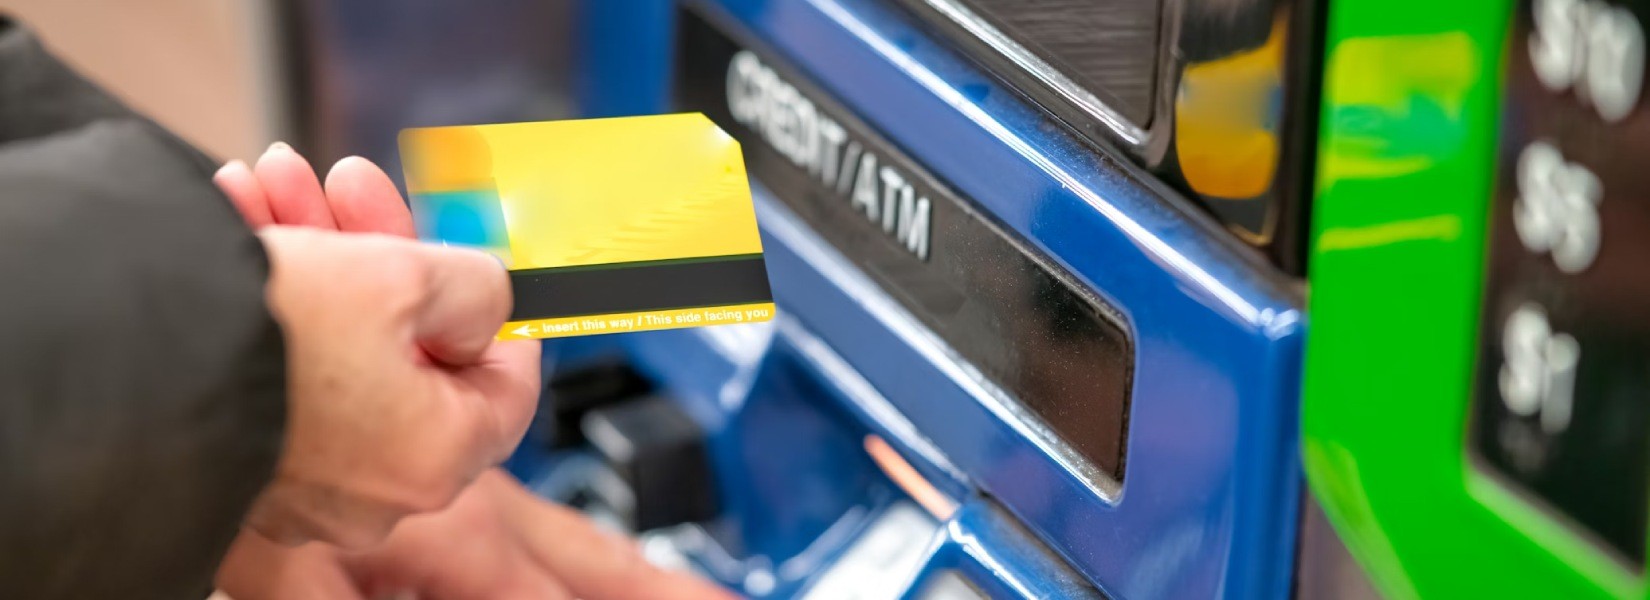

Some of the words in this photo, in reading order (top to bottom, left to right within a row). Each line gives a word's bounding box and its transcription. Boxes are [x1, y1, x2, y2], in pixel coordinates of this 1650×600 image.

[726, 49, 932, 261] CREDIT/ATM
[1513, 140, 1604, 274] $5
[542, 322, 580, 333] Insert
[582, 320, 607, 331] this
[610, 318, 635, 330] way
[645, 312, 673, 325] This
[675, 311, 702, 324] side
[704, 309, 743, 322] facing
[746, 308, 769, 320] you
